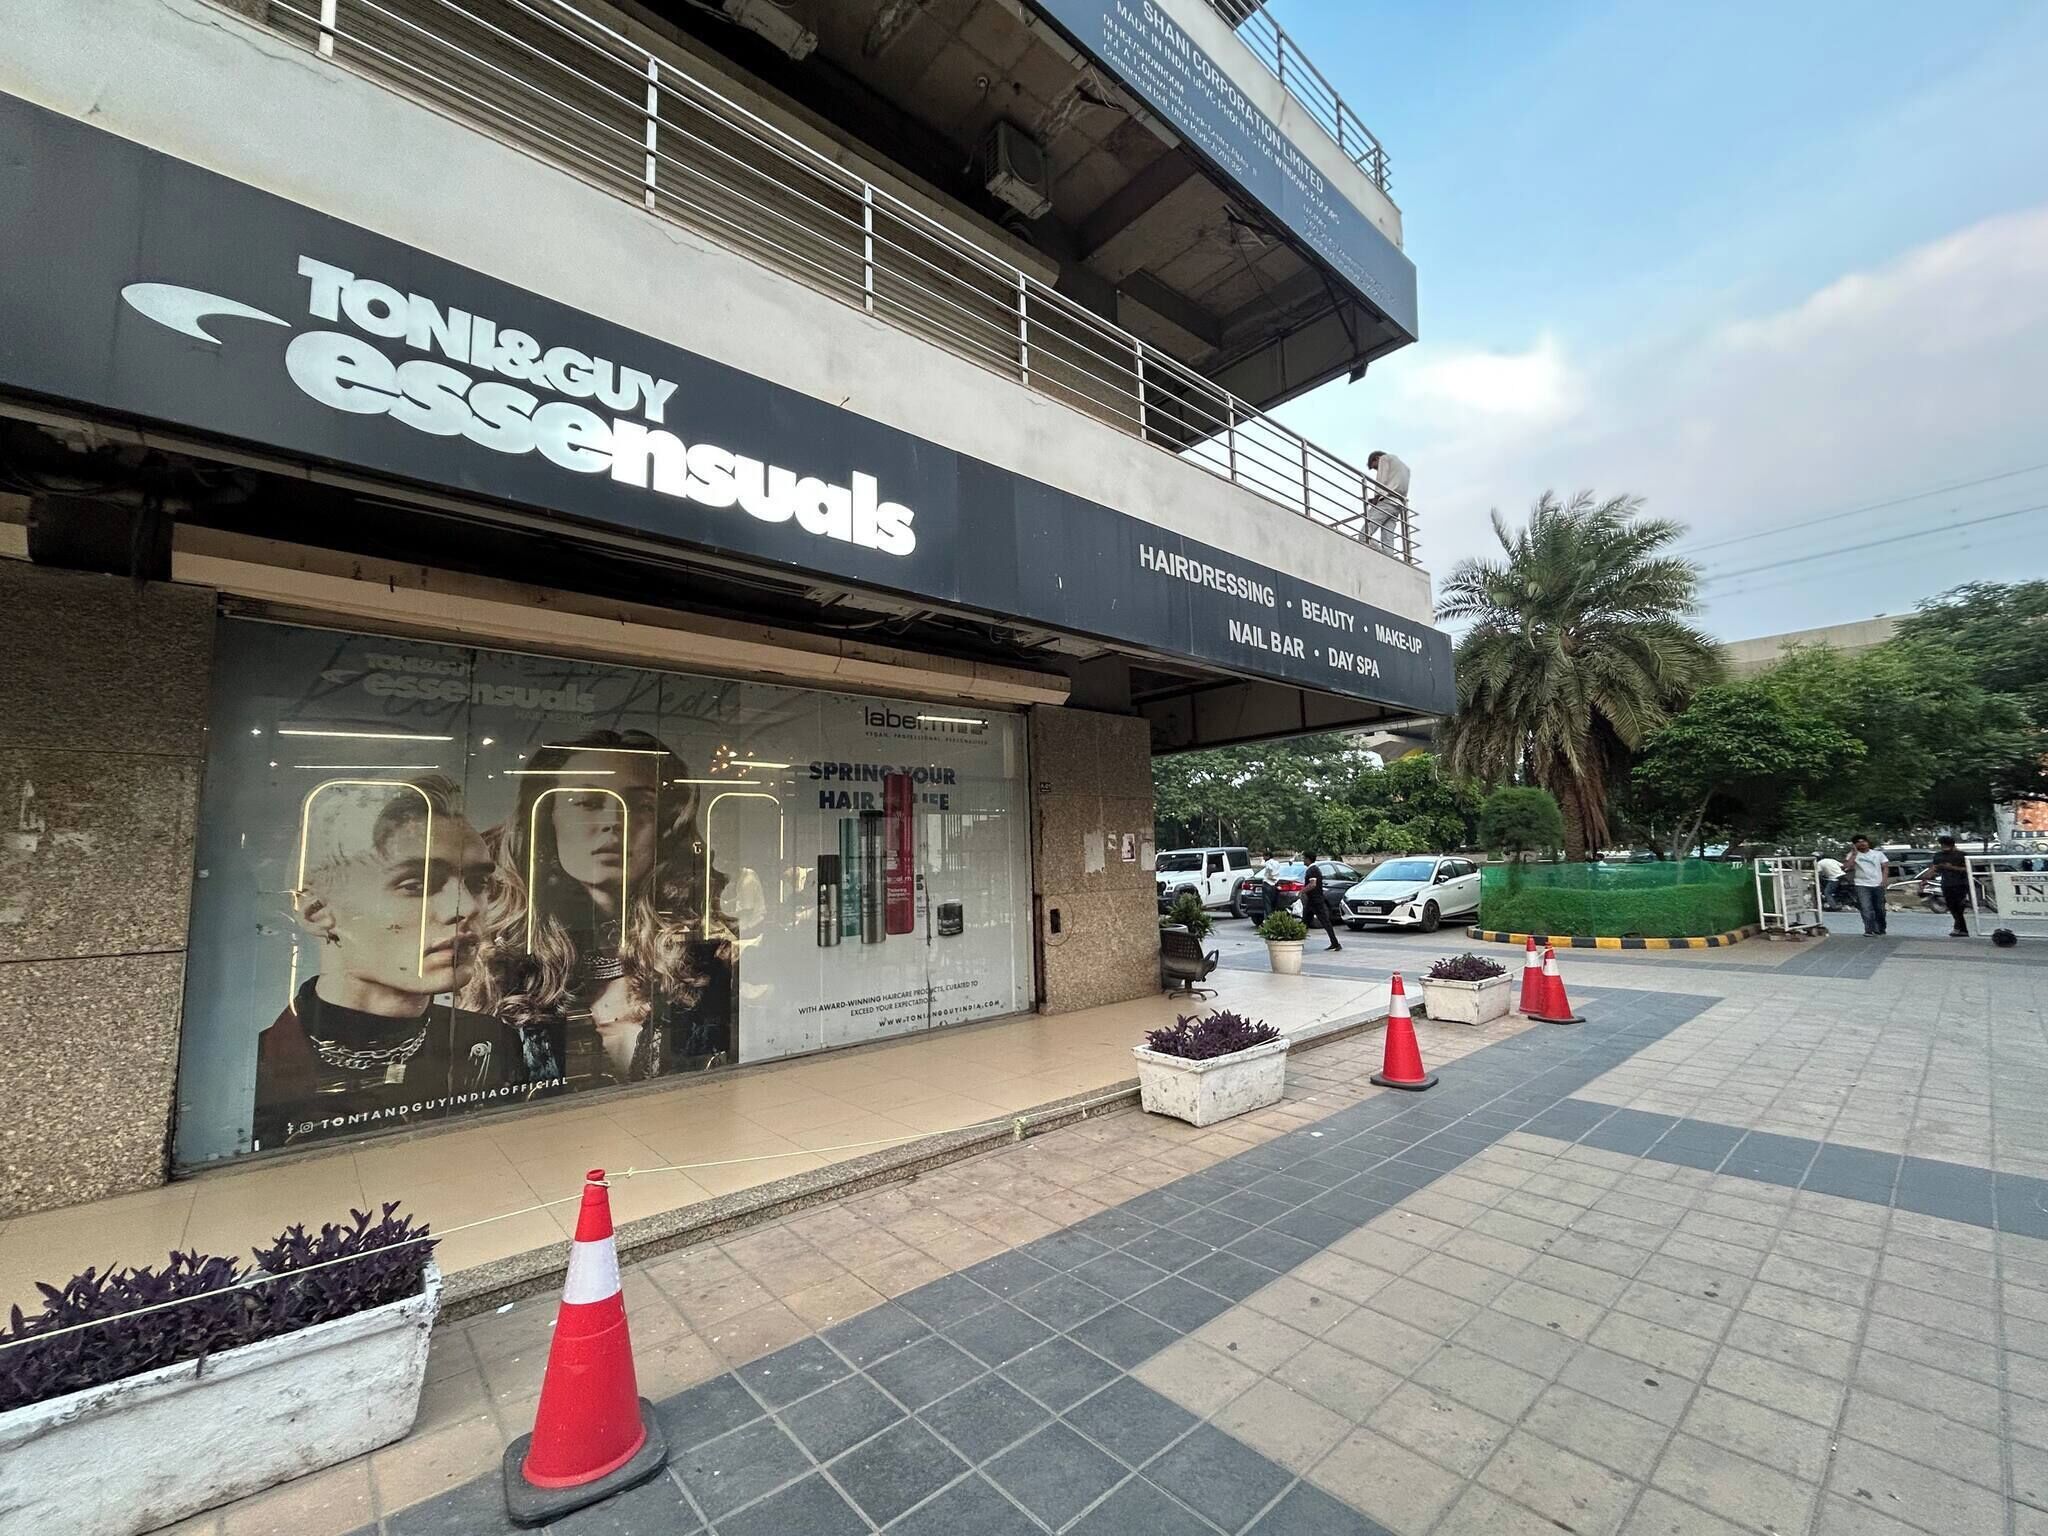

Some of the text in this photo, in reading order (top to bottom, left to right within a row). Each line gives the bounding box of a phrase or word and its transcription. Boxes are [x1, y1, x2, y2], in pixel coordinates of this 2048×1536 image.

[1117, 1, 1149, 40] MADE
[1152, 34, 1162, 51] IN
[1165, 44, 1191, 79] INDIA
[1274, 155, 1309, 195] WINDOWS
[1144, 1, 1190, 59] SHANI
[1193, 51, 1281, 150] CORPORATION
[1283, 142, 1324, 193] LIMITED
[298, 255, 680, 423] TONI&GUY
[285, 329, 917, 557] essensuals
[1139, 543, 1422, 654] HAIRDRESSING BEAUTY MAKE-UP
[1229, 619, 1380, 679] NAIL BAR DAY SPA
[809, 760, 894, 783] SPRING
[818, 790, 876, 810] HAIR
[798, 1005, 817, 1015] WITH
[818, 996, 881, 1012] AWARD-WINNING
[882, 990, 913, 1001] HAIRCARE
[971, 979, 979, 987] TO
[850, 1007, 874, 1017] EXCEED
[875, 1003, 894, 1013] YOUR
[321, 1076, 569, 1130] TONIANDGUYINDIAOFFICIAL
